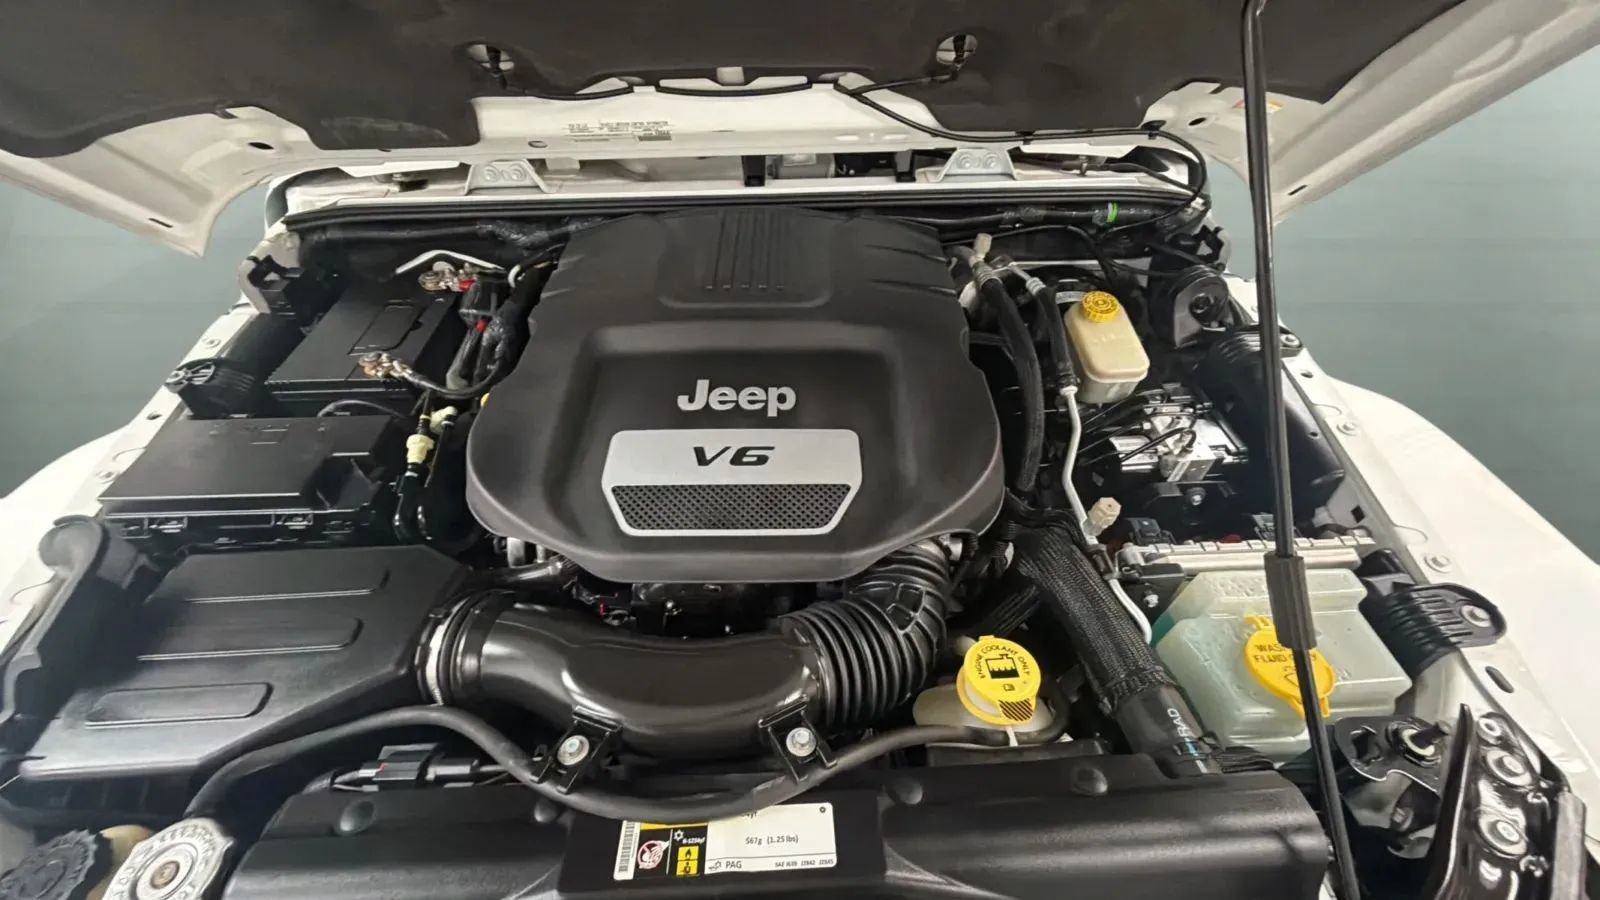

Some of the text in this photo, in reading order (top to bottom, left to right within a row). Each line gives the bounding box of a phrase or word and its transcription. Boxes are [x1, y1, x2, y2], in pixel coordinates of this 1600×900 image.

[677, 379, 796, 417] Jeep
[693, 446, 776, 467] V6
[981, 644, 1018, 656] COOLANT
[1253, 654, 1287, 663] FLUID
[745, 834, 799, 846] 567g (1.25 lbs)
[725, 860, 742, 869] PAG
